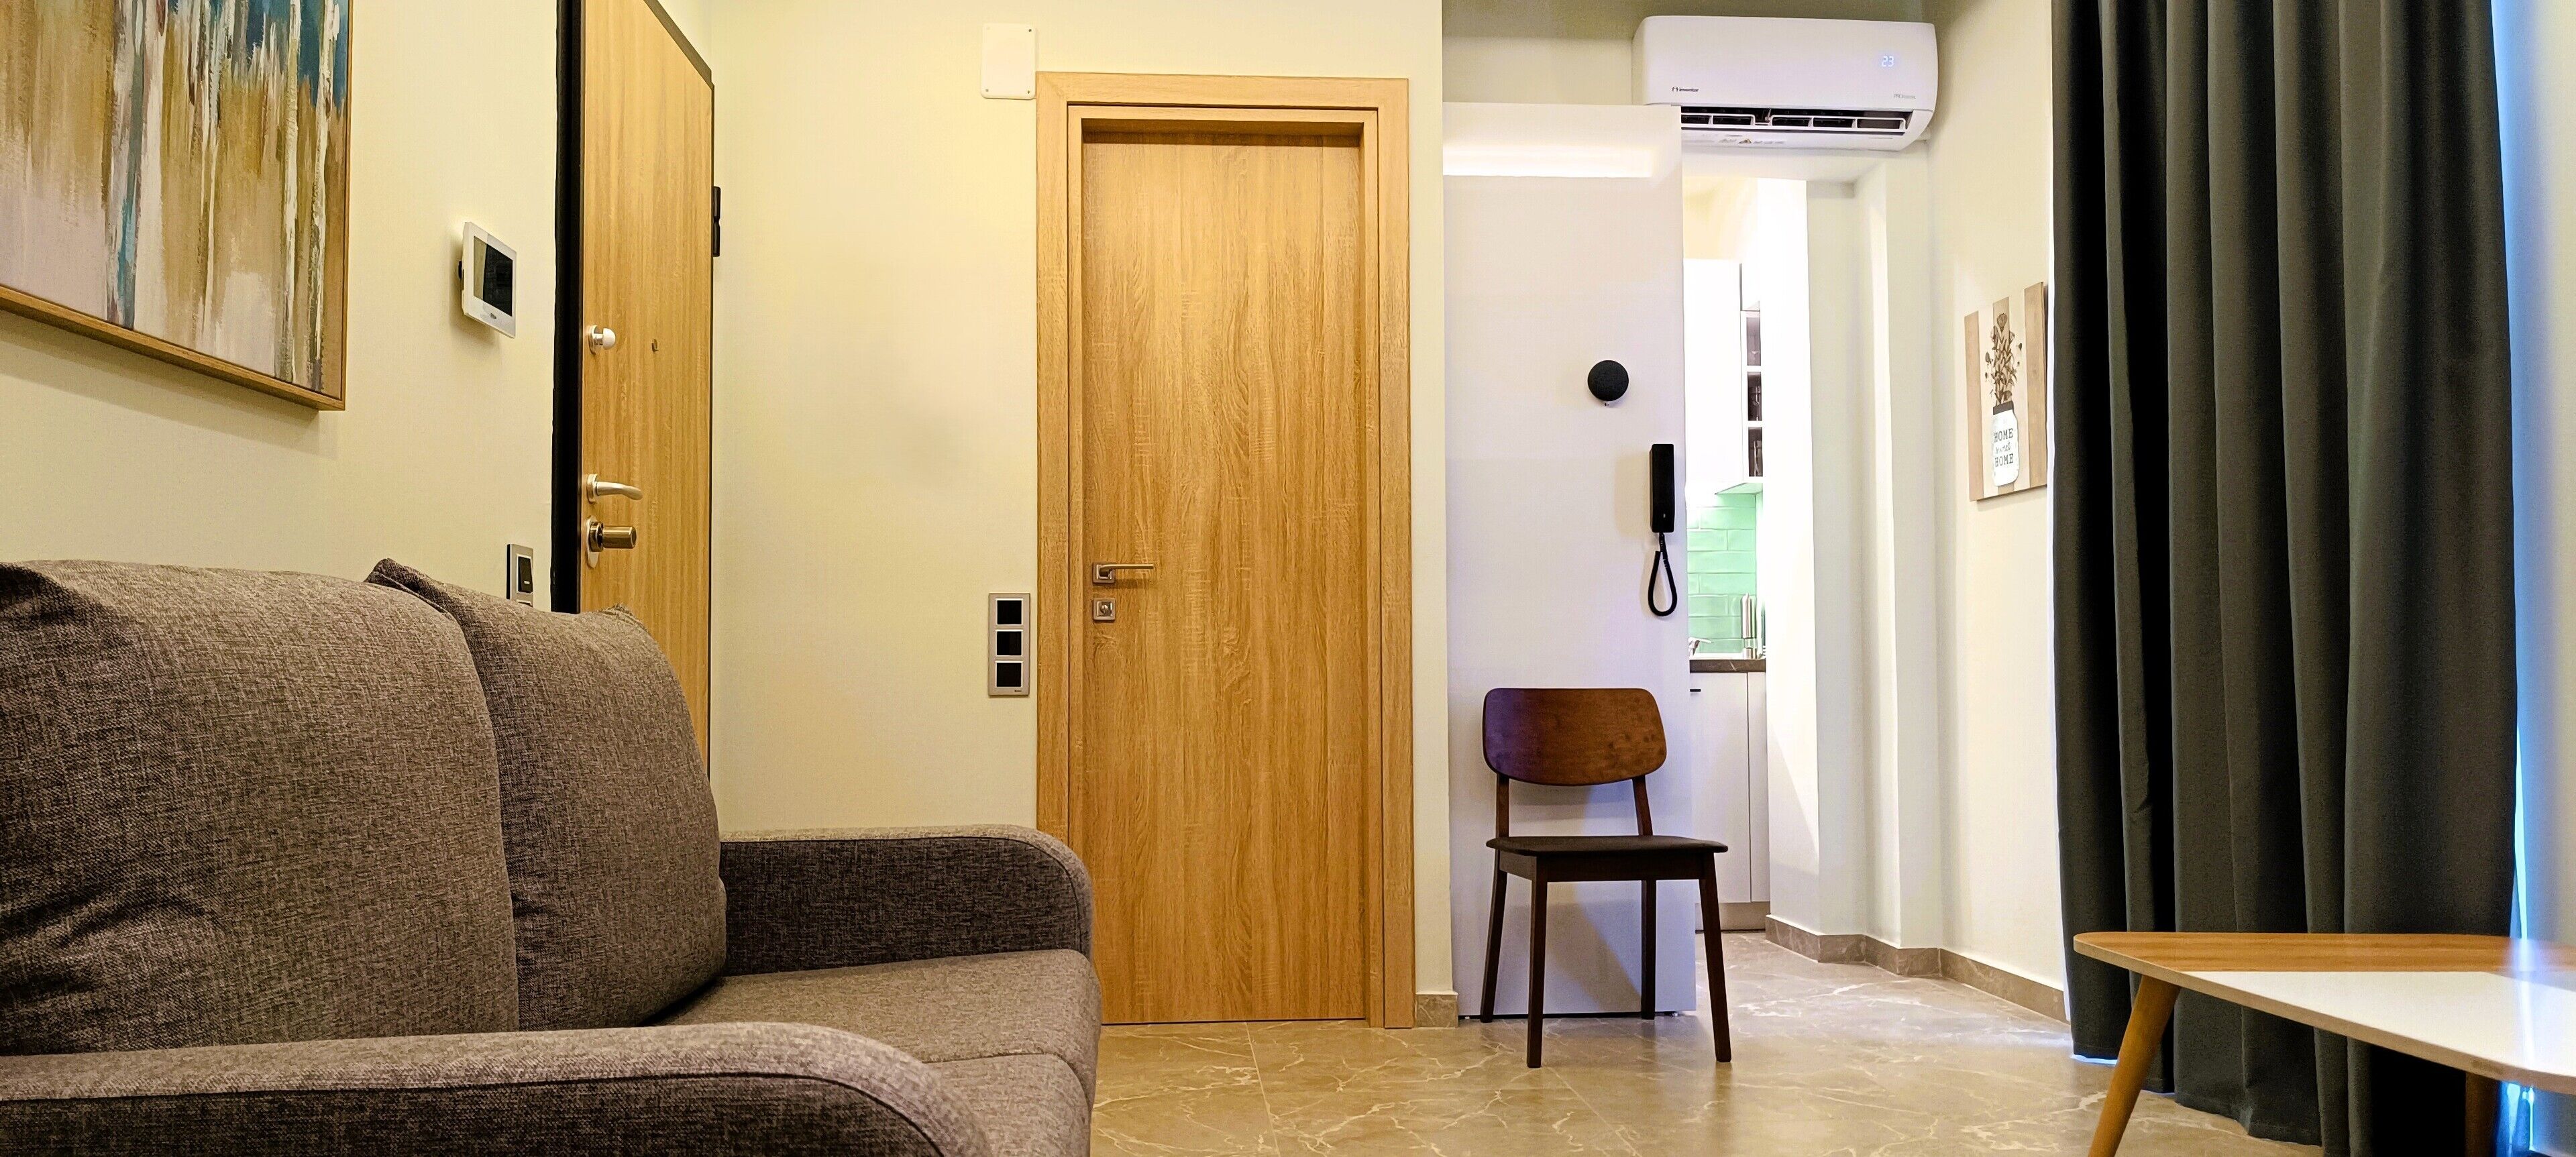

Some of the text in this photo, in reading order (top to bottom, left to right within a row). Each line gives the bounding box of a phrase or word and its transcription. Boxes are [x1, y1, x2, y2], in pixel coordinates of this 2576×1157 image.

[1882, 56, 1894, 67] 23
[1994, 428, 2013, 443] HOME
[1995, 453, 2014, 467] HOME
